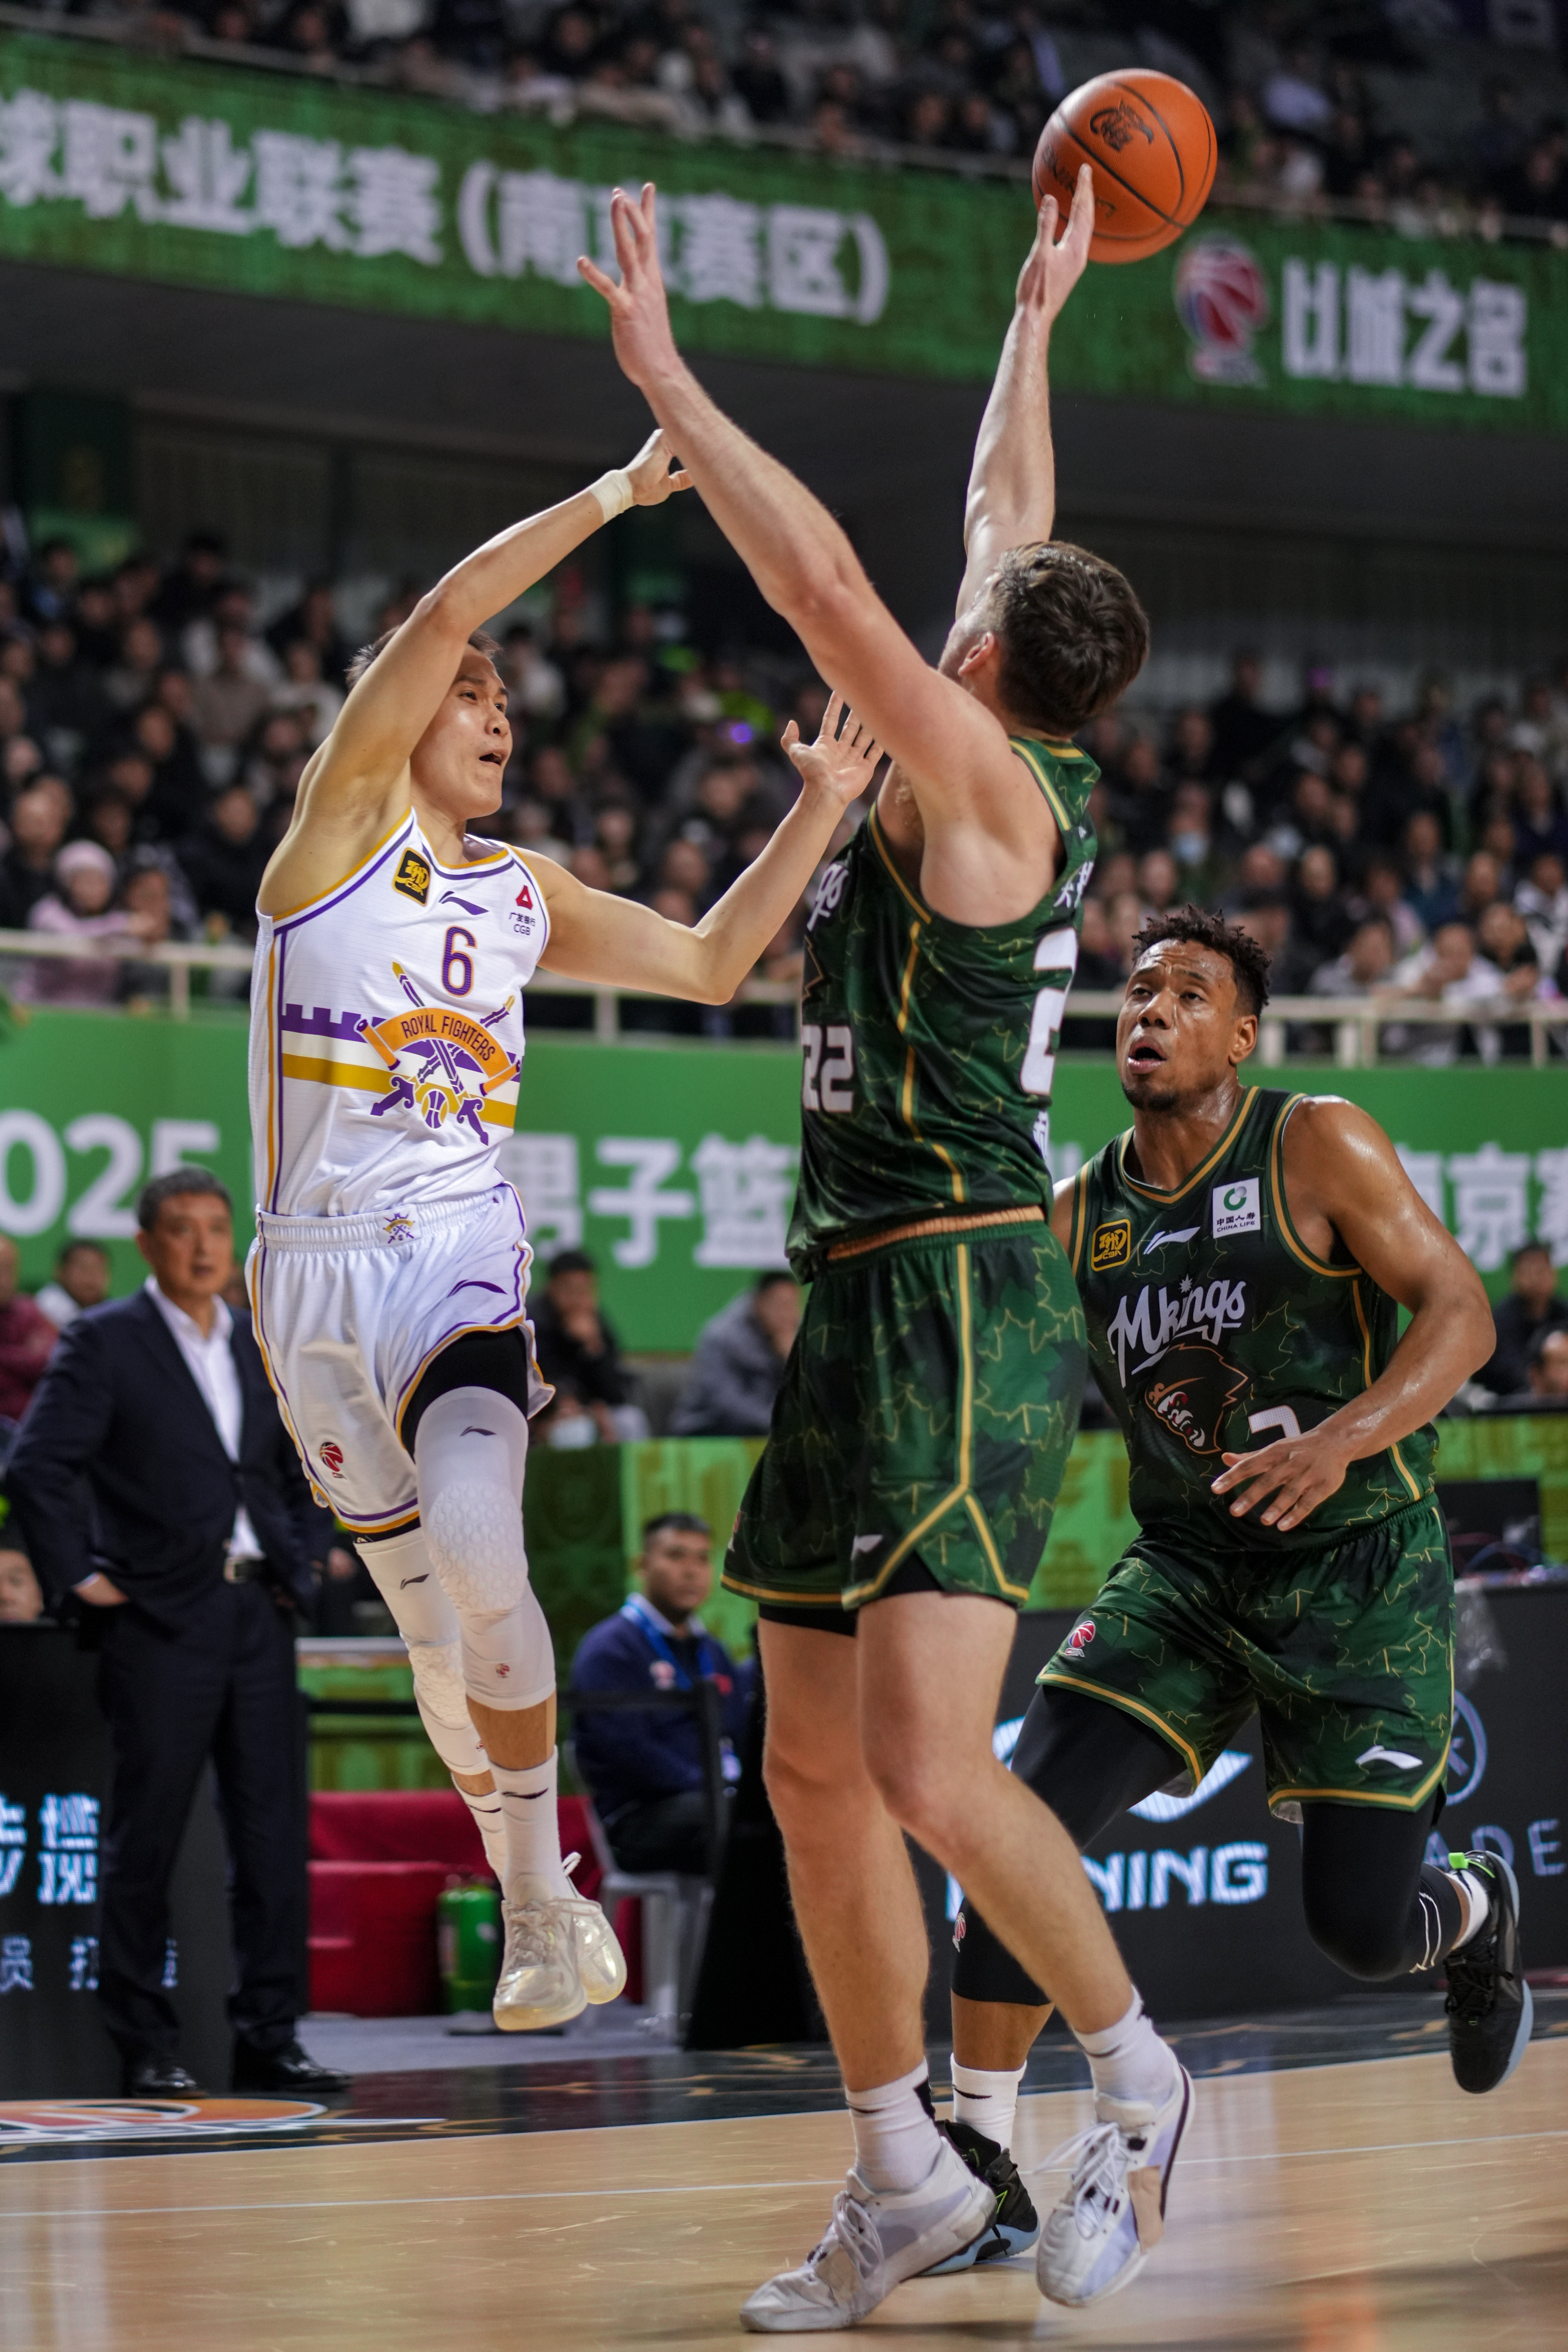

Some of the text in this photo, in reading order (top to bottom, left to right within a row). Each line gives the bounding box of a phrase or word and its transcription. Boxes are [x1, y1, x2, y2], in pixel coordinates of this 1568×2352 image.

[508, 912, 536, 927] 广发银行
[513, 924, 530, 936] CGB
[442, 925, 477, 998] 6
[400, 1014, 496, 1061] ROYAL FIGHTERS
[1216, 1212, 1256, 1227] 中国人寿
[1216, 1224, 1238, 1232] CHINA
